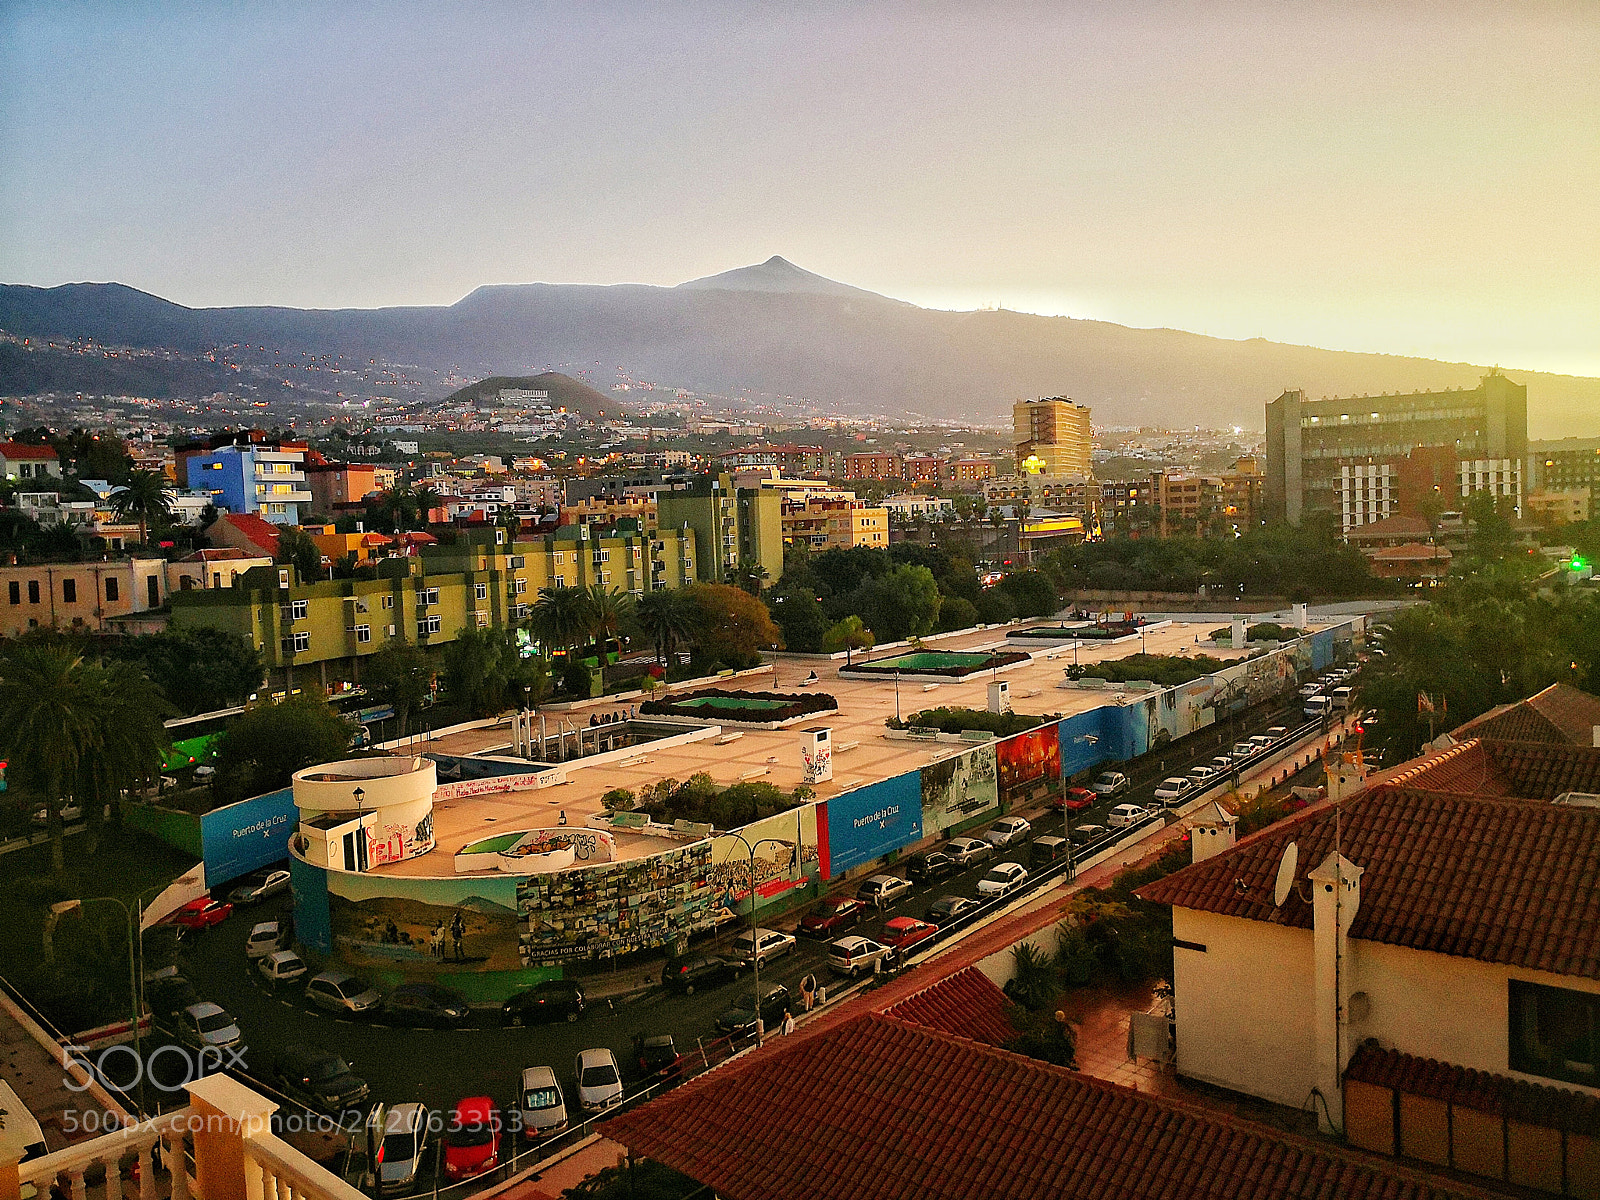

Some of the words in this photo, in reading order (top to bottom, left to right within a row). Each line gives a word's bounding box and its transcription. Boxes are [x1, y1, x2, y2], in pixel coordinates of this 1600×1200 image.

[232, 825, 255, 839] Puerto
[256, 821, 265, 831] de
[265, 818, 272, 827] la
[272, 814, 287, 825] Cruz
[853, 815, 874, 828] Puerto
[874, 810, 881, 820] de
[887, 804, 900, 816] Cruz
[531, 948, 559, 957] GRACIAS
[575, 941, 611, 952] COLABORAR
